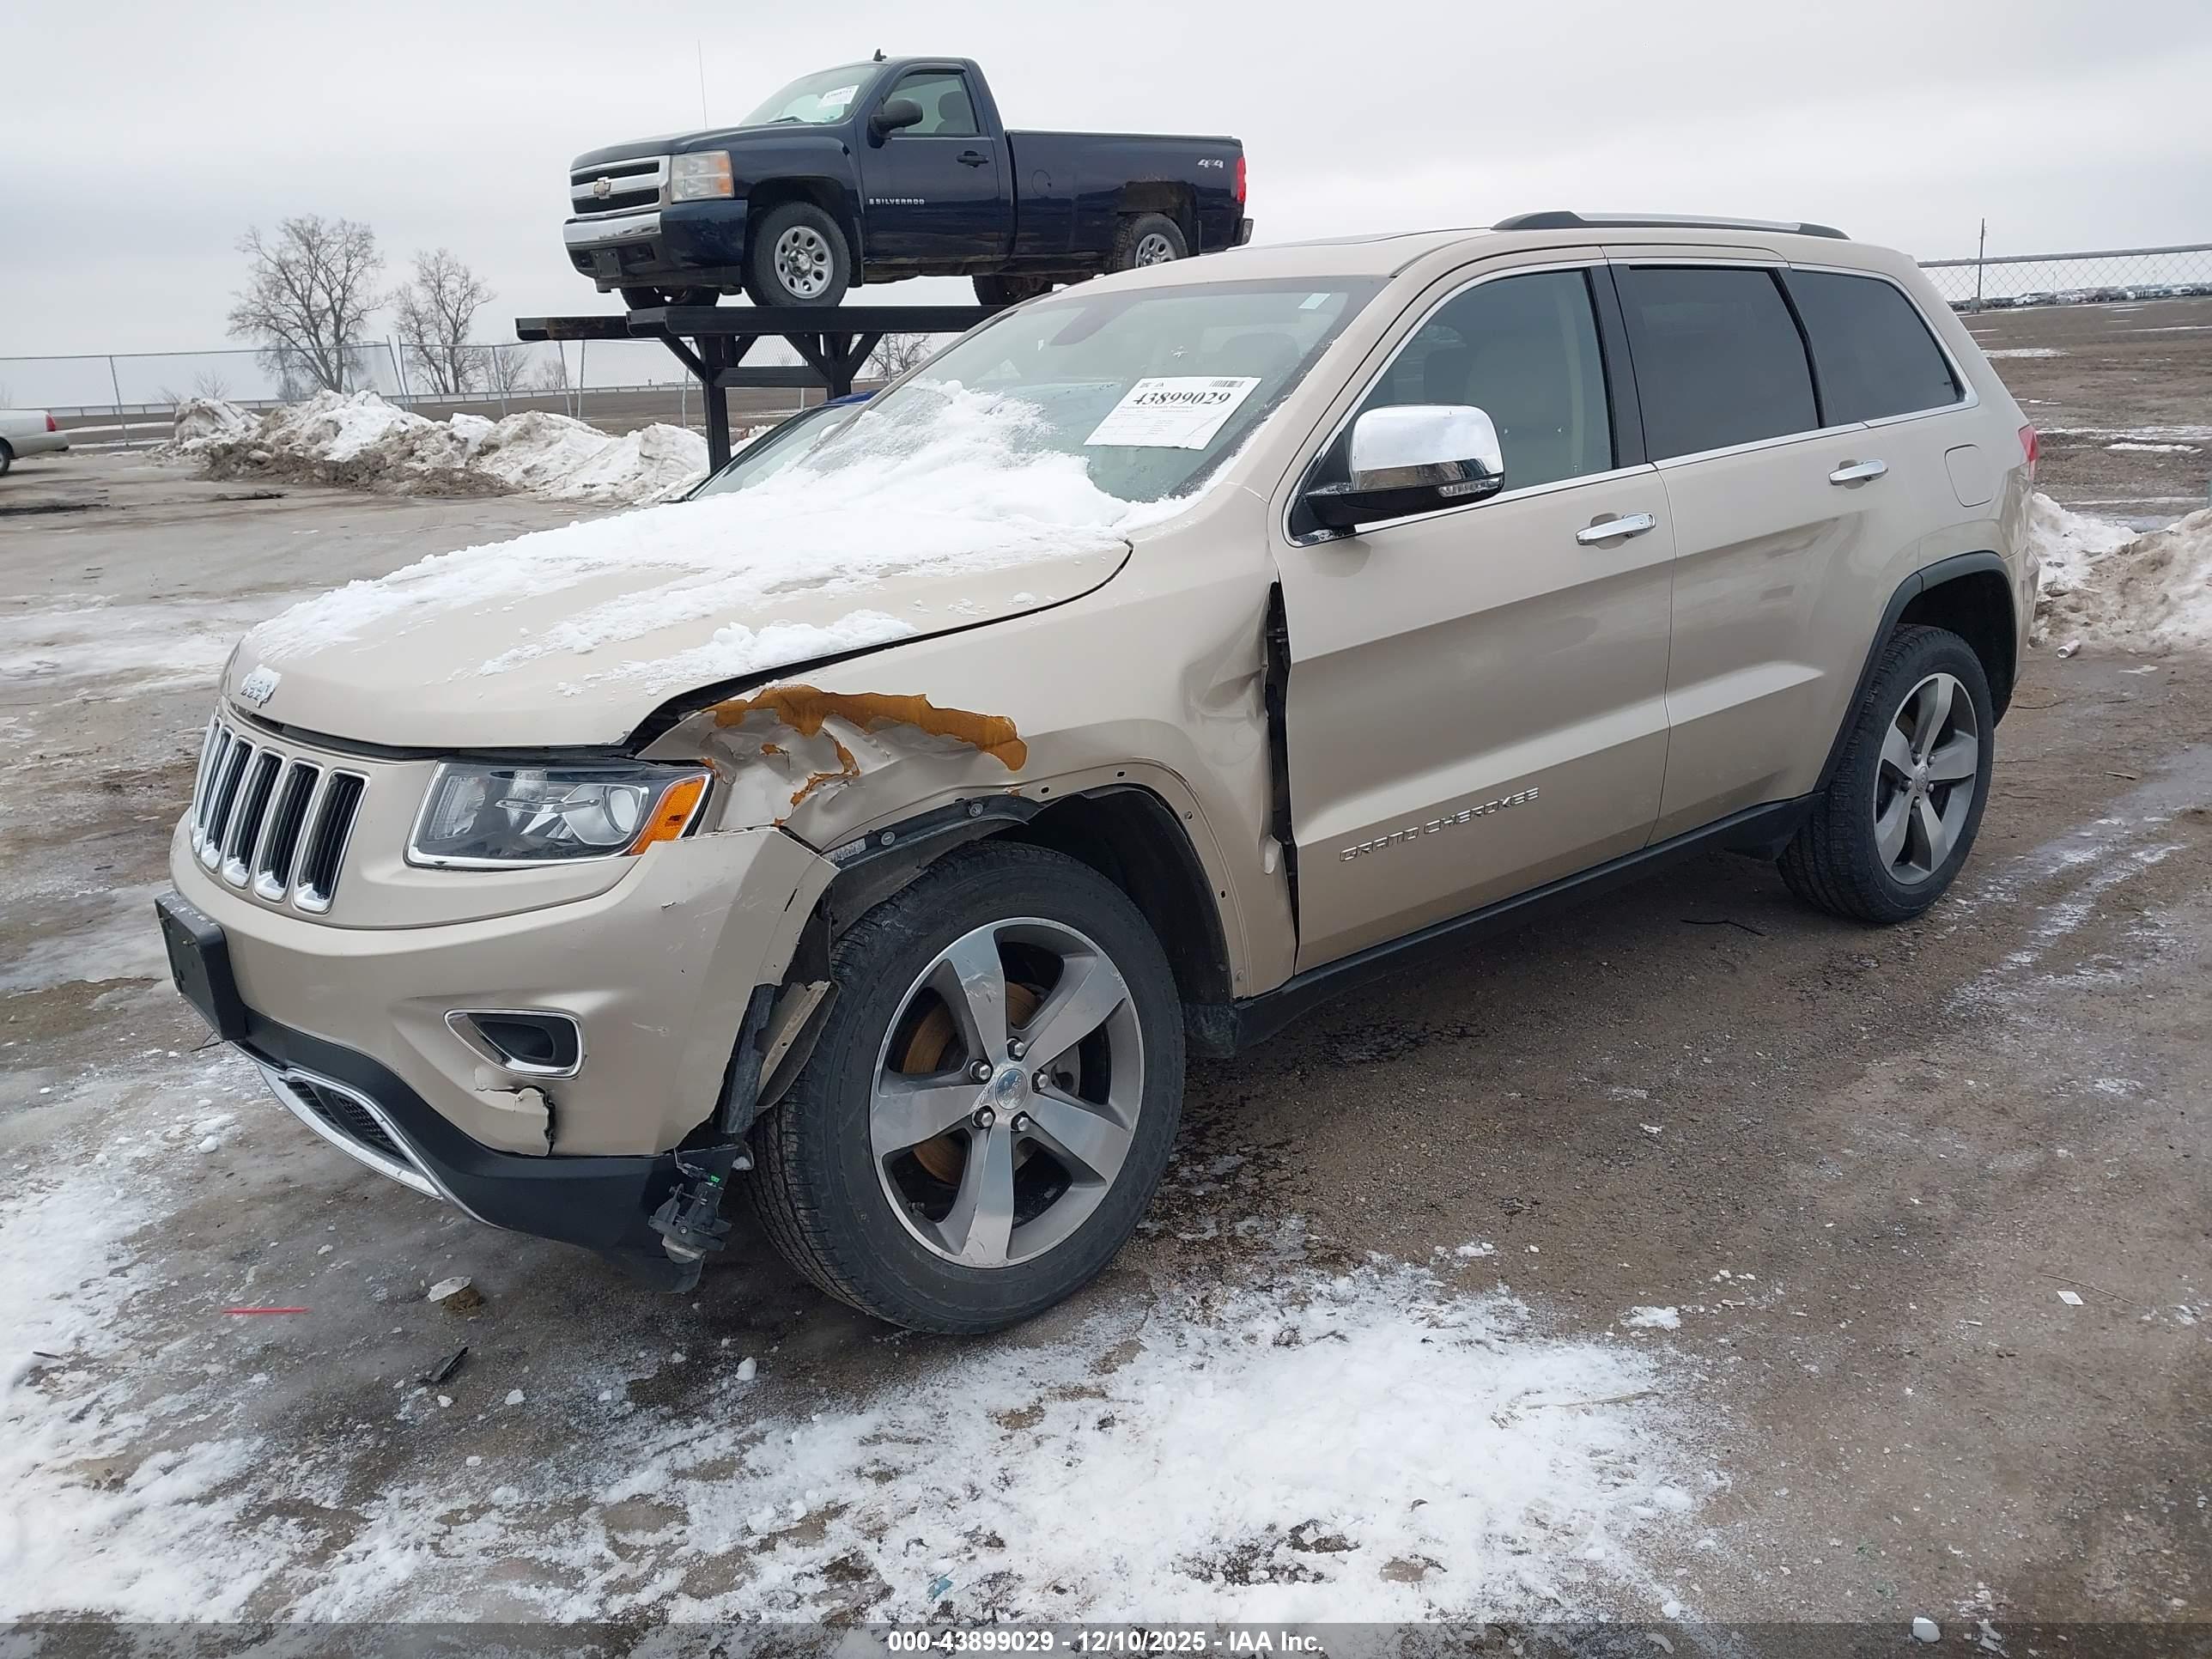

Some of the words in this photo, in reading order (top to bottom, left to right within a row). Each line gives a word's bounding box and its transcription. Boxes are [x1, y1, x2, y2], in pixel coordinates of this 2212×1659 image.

[1133, 392, 1231, 405] 43899029
[1340, 827, 1419, 861] GRAND
[1424, 787, 1540, 835] CHEROKEE
